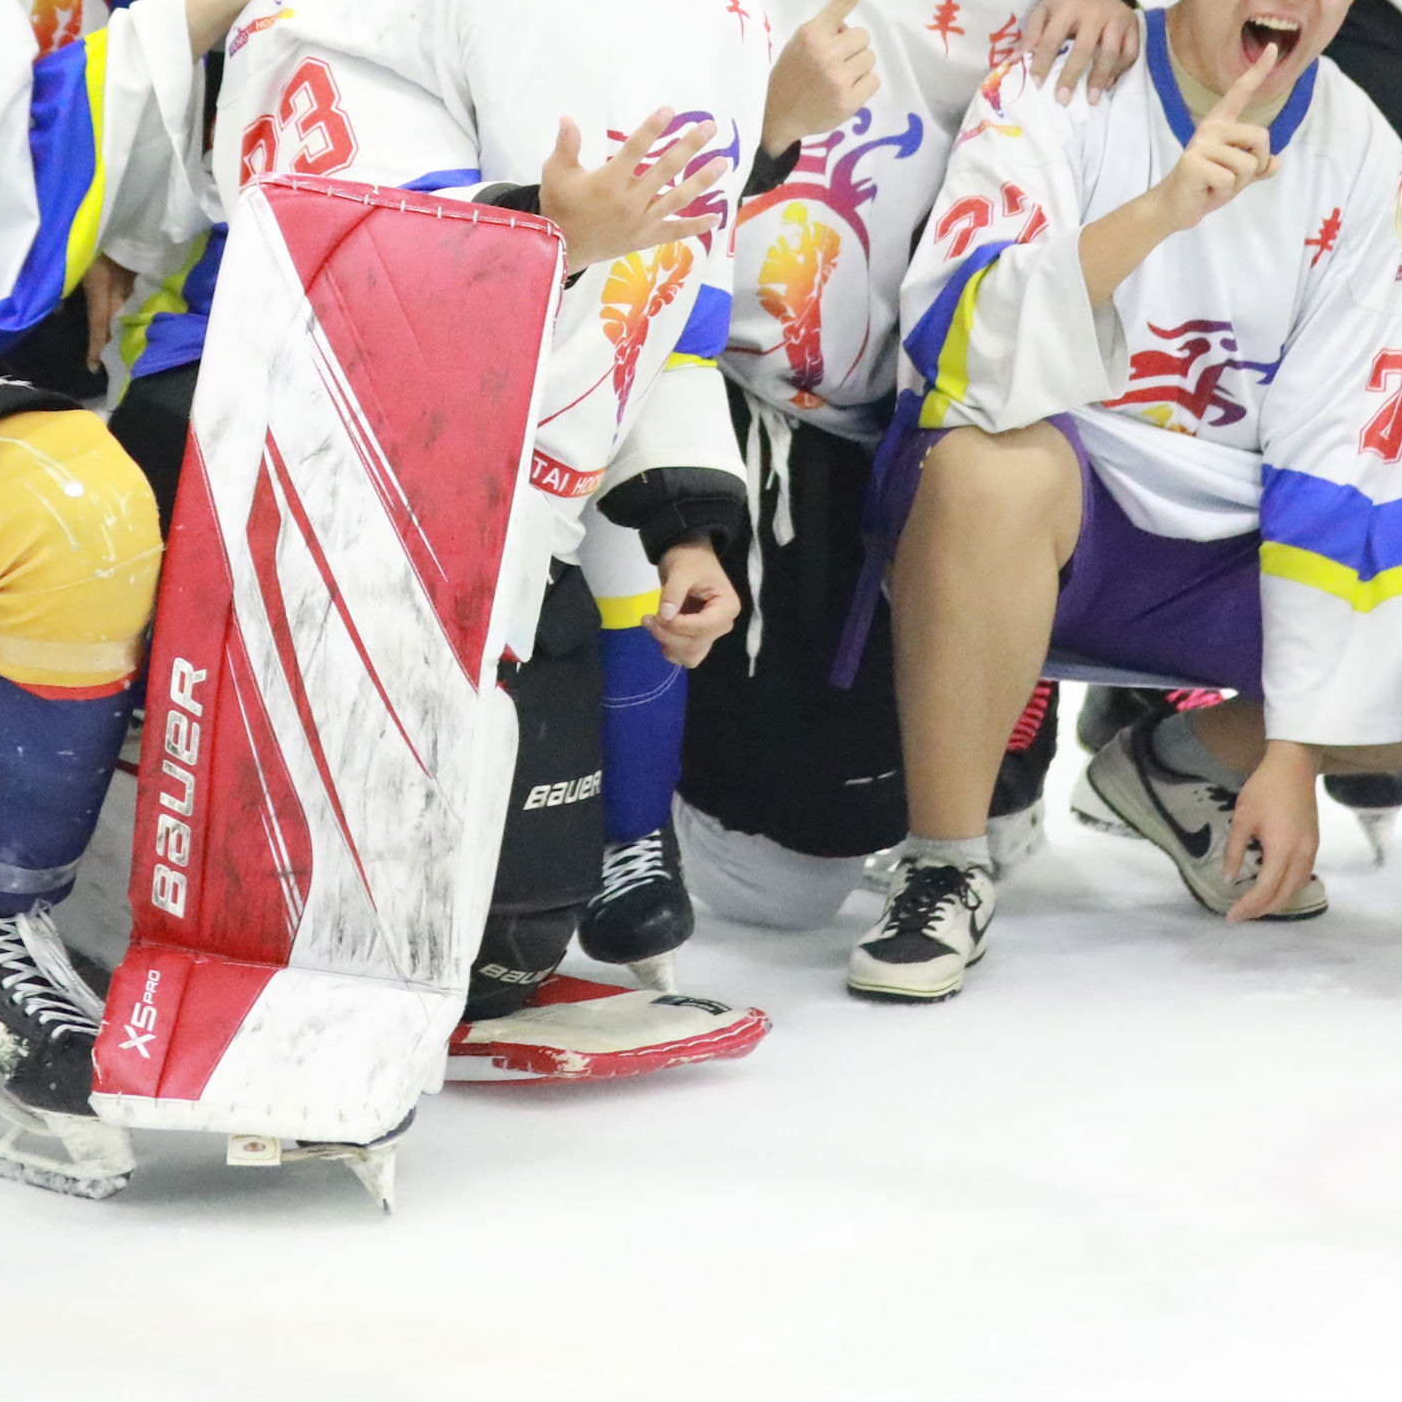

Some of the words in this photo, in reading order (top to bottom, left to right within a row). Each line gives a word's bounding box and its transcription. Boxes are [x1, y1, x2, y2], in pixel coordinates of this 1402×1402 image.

[150, 656, 208, 920] BAUER
[117, 1006, 158, 1060] X5
[142, 968, 161, 1005] PRO
